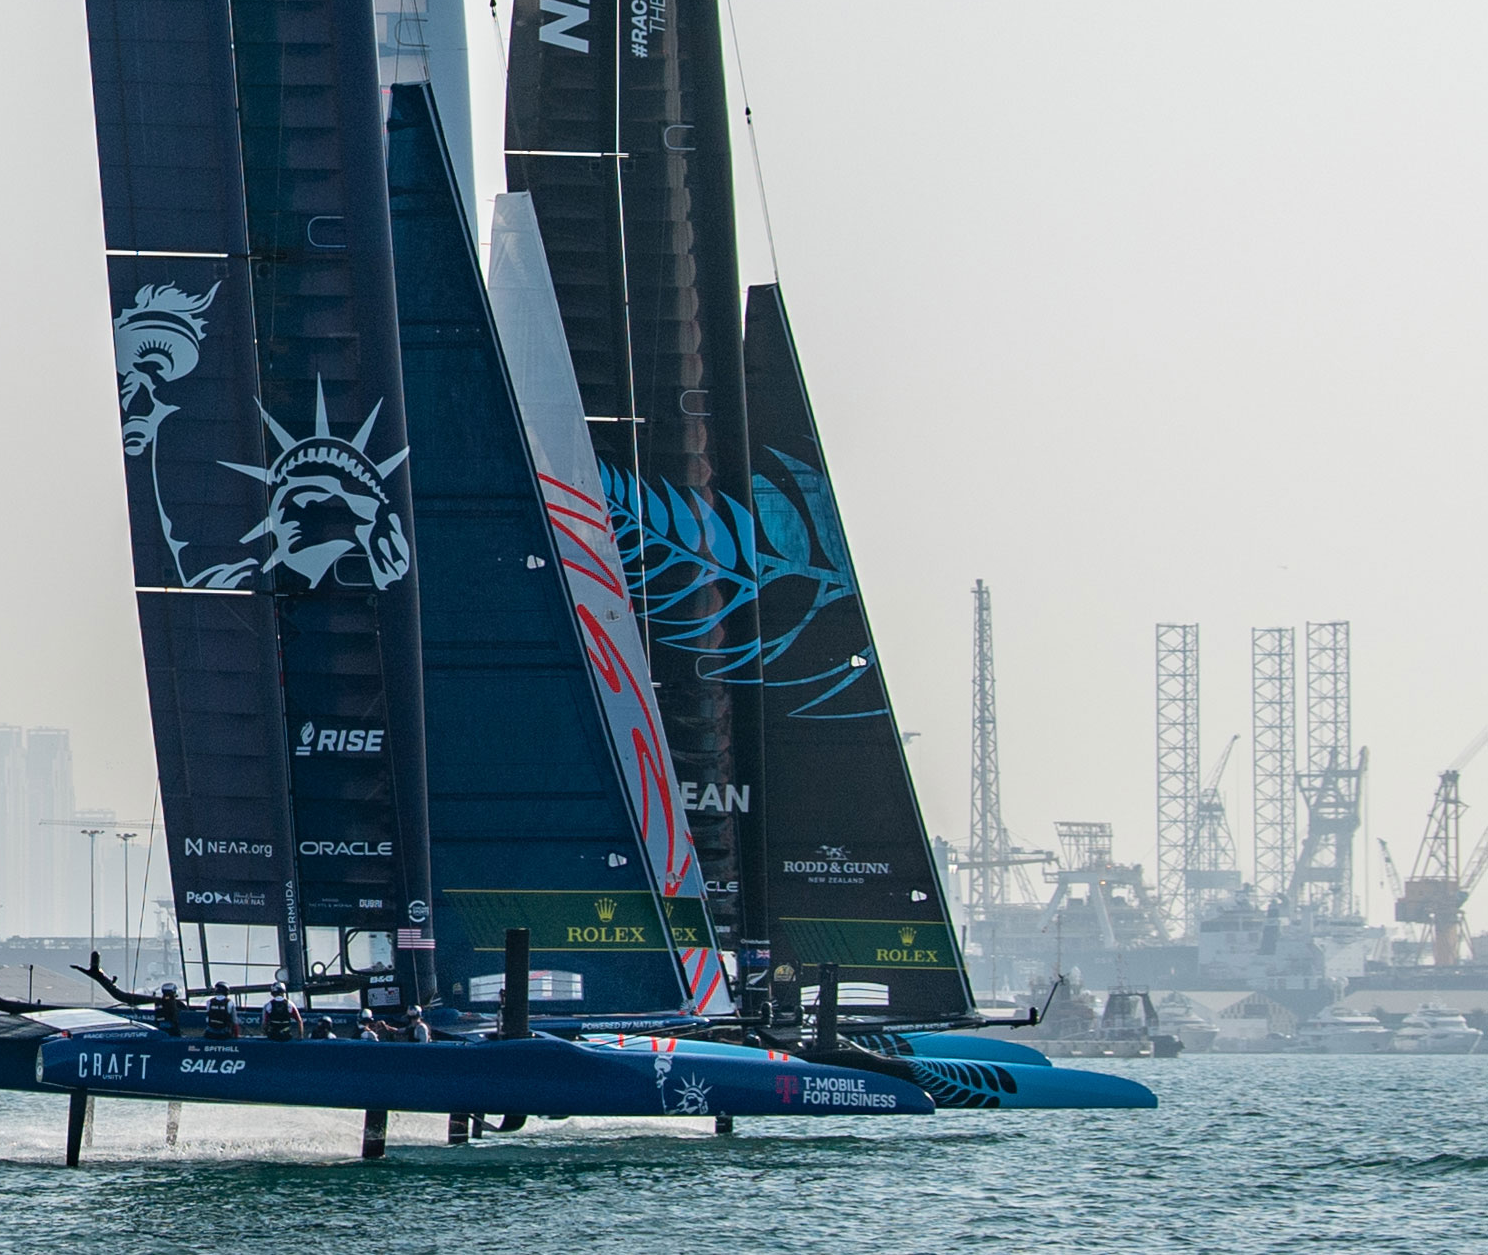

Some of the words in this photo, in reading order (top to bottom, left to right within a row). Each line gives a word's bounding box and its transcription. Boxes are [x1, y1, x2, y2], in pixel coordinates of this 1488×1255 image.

[316, 729, 385, 752] RISE
[679, 781, 750, 813] EAN
[207, 840, 273, 858] NEAR.org
[299, 841, 393, 856] ORACLE
[783, 861, 828, 873] RODD
[829, 861, 842, 874] &
[843, 862, 890, 874] GUNN
[705, 880, 739, 893] CLE
[186, 891, 214, 904] P&O
[285, 880, 298, 942] BERMUDA
[567, 926, 646, 943] ROLEX
[876, 948, 939, 963] ROLEX
[78, 1052, 151, 1080] CRAFT
[803, 1076, 866, 1093] T-MOBILE
[803, 1090, 830, 1105] FOR
[832, 1092, 897, 1109] BUSINESS
